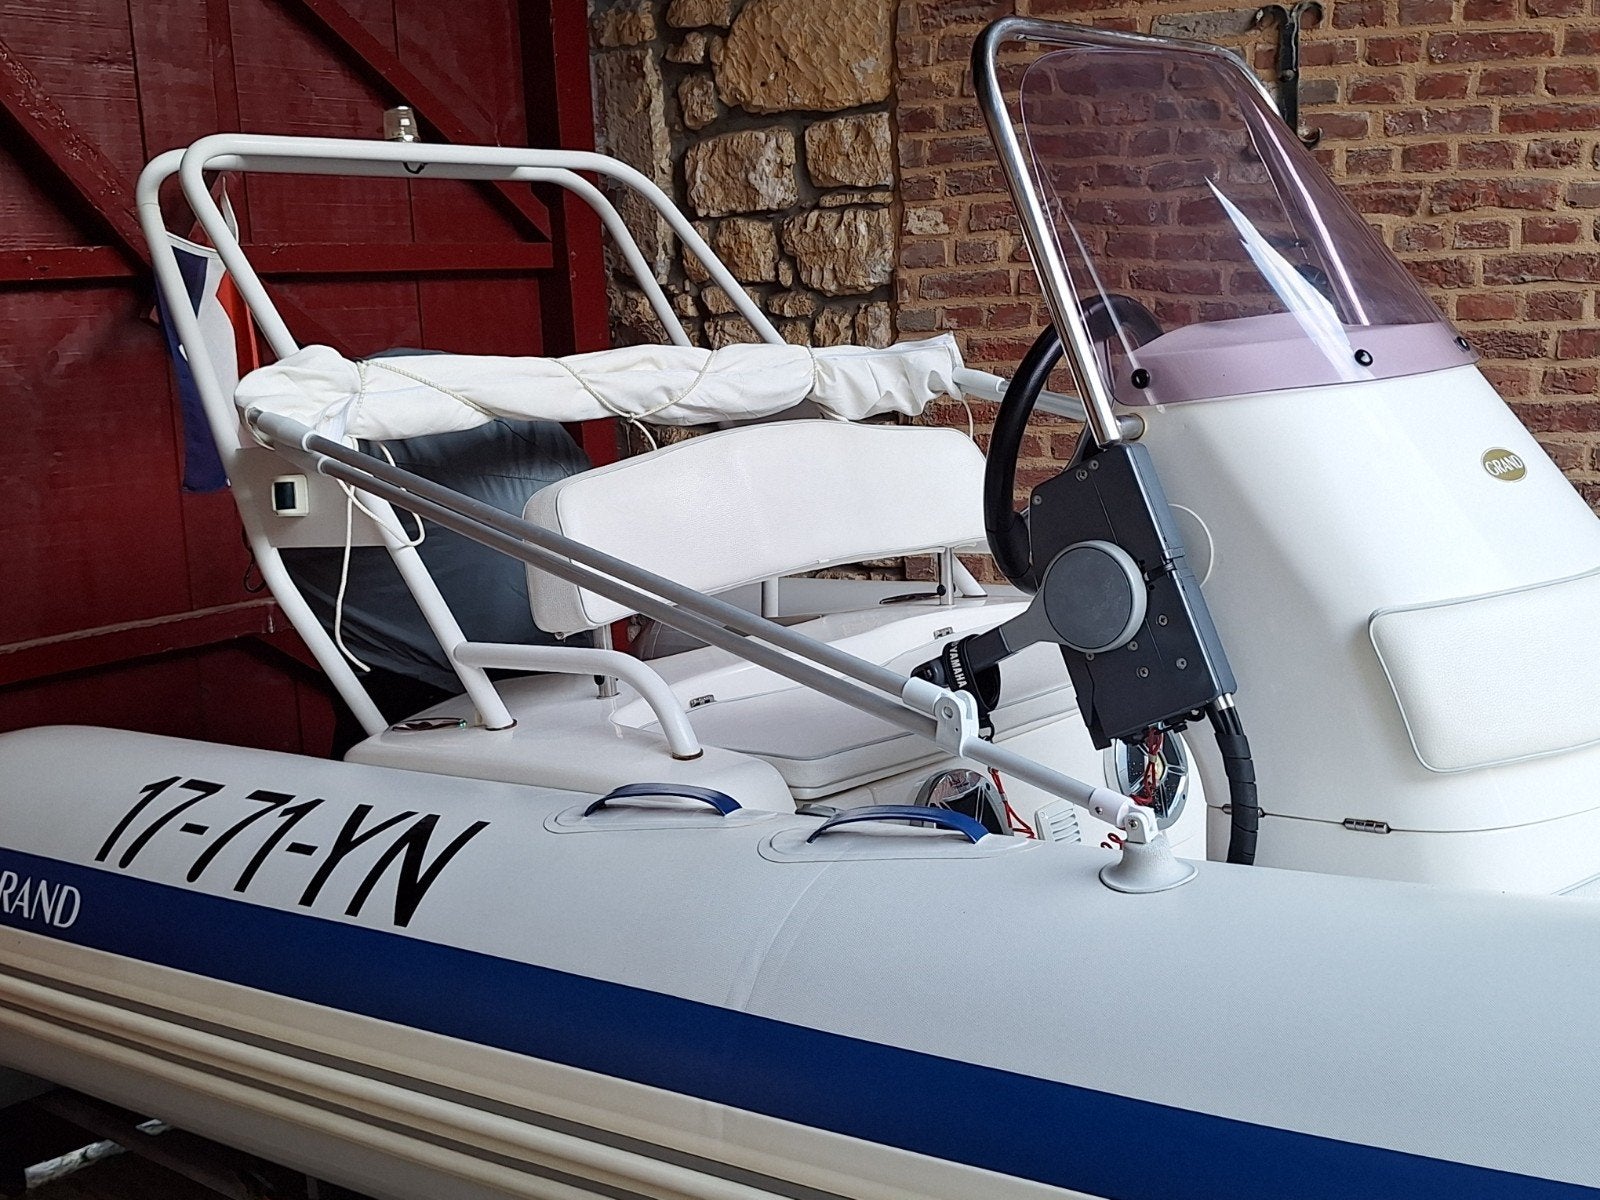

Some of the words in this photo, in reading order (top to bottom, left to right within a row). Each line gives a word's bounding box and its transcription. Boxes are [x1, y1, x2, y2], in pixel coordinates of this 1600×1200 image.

[1485, 455, 1523, 476] GRAND
[949, 646, 968, 689] YAMAHA
[94, 775, 492, 928] 17-71-YN
